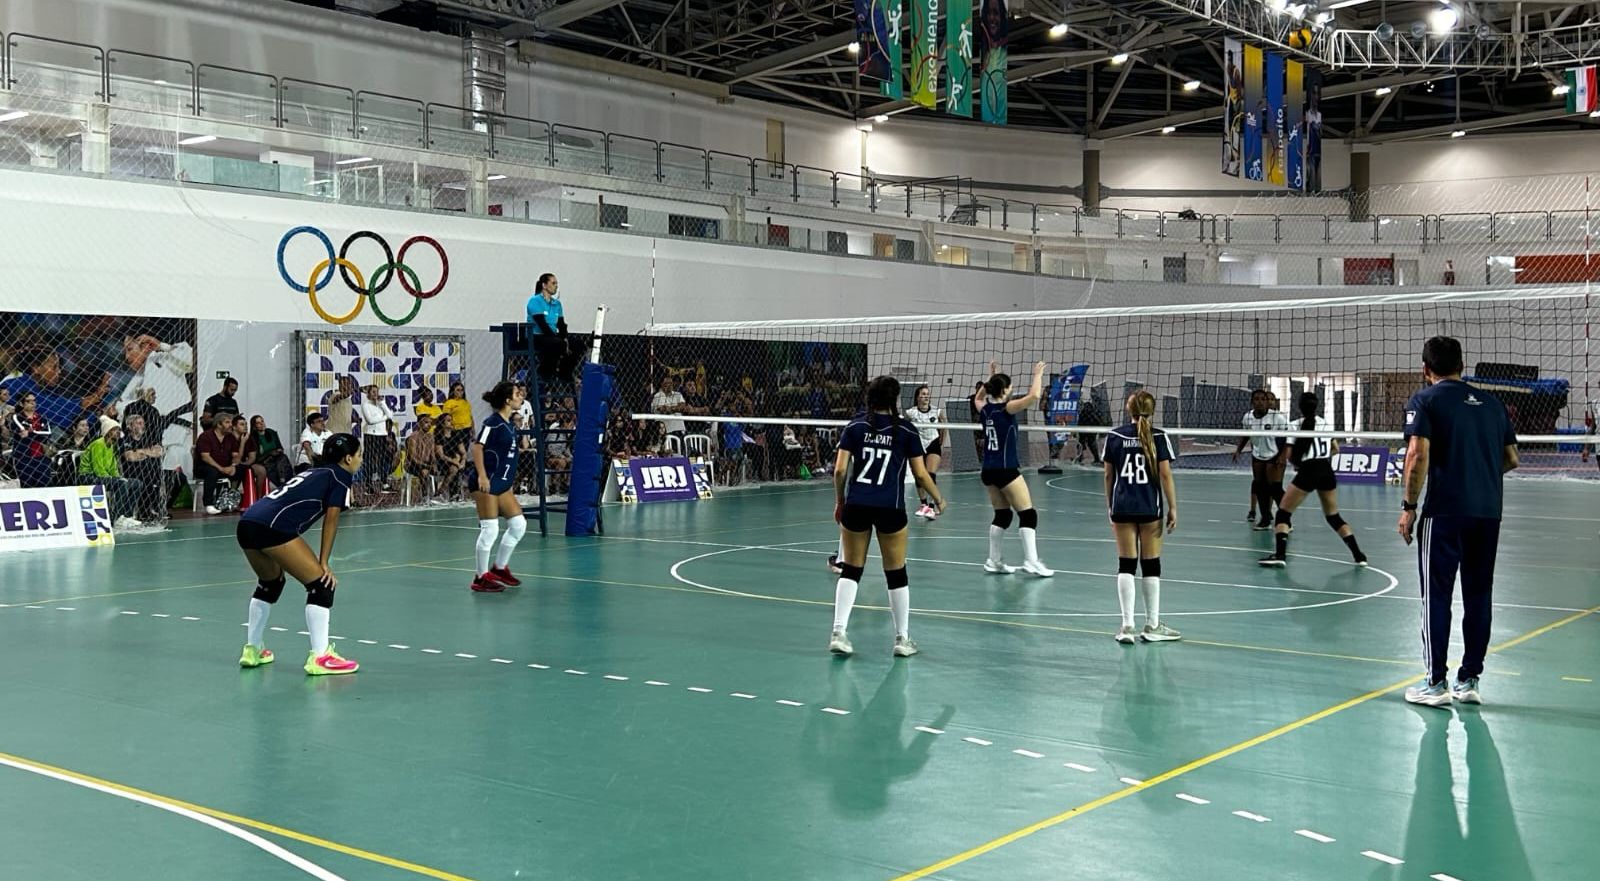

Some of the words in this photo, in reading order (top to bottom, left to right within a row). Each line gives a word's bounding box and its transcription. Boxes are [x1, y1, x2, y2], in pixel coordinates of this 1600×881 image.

[384, 394, 406, 412] RJ
[1053, 400, 1077, 411] JERJ
[640, 465, 688, 489] JERJ
[856, 446, 892, 485] 27
[1120, 453, 1148, 484] 48
[0, 499, 69, 532] ERJ
